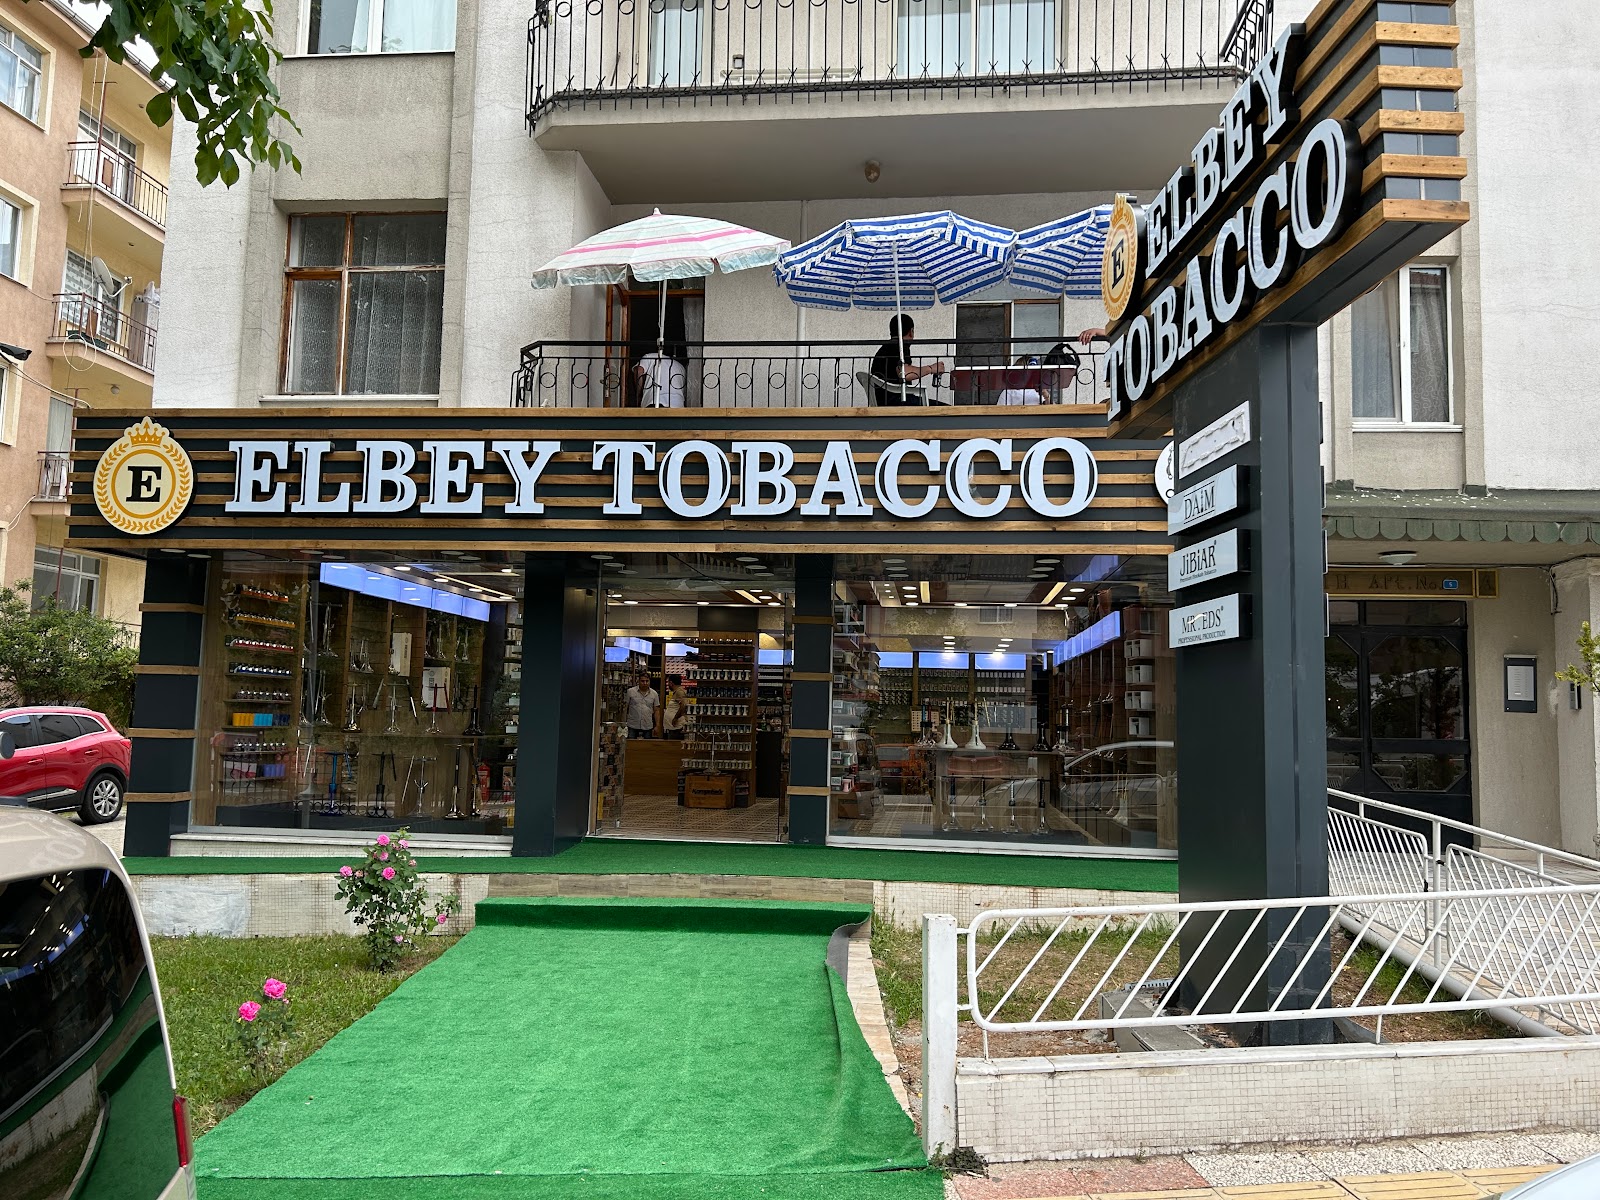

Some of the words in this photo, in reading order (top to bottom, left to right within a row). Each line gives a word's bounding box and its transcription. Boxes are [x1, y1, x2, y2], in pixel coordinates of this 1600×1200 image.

[1145, 23, 1302, 279] ELBEY
[1104, 118, 1349, 421] TOBACCO
[1111, 238, 1125, 290] E
[126, 465, 162, 503] E
[225, 439, 562, 516] ELBEY
[592, 436, 1099, 519] TOBACCO
